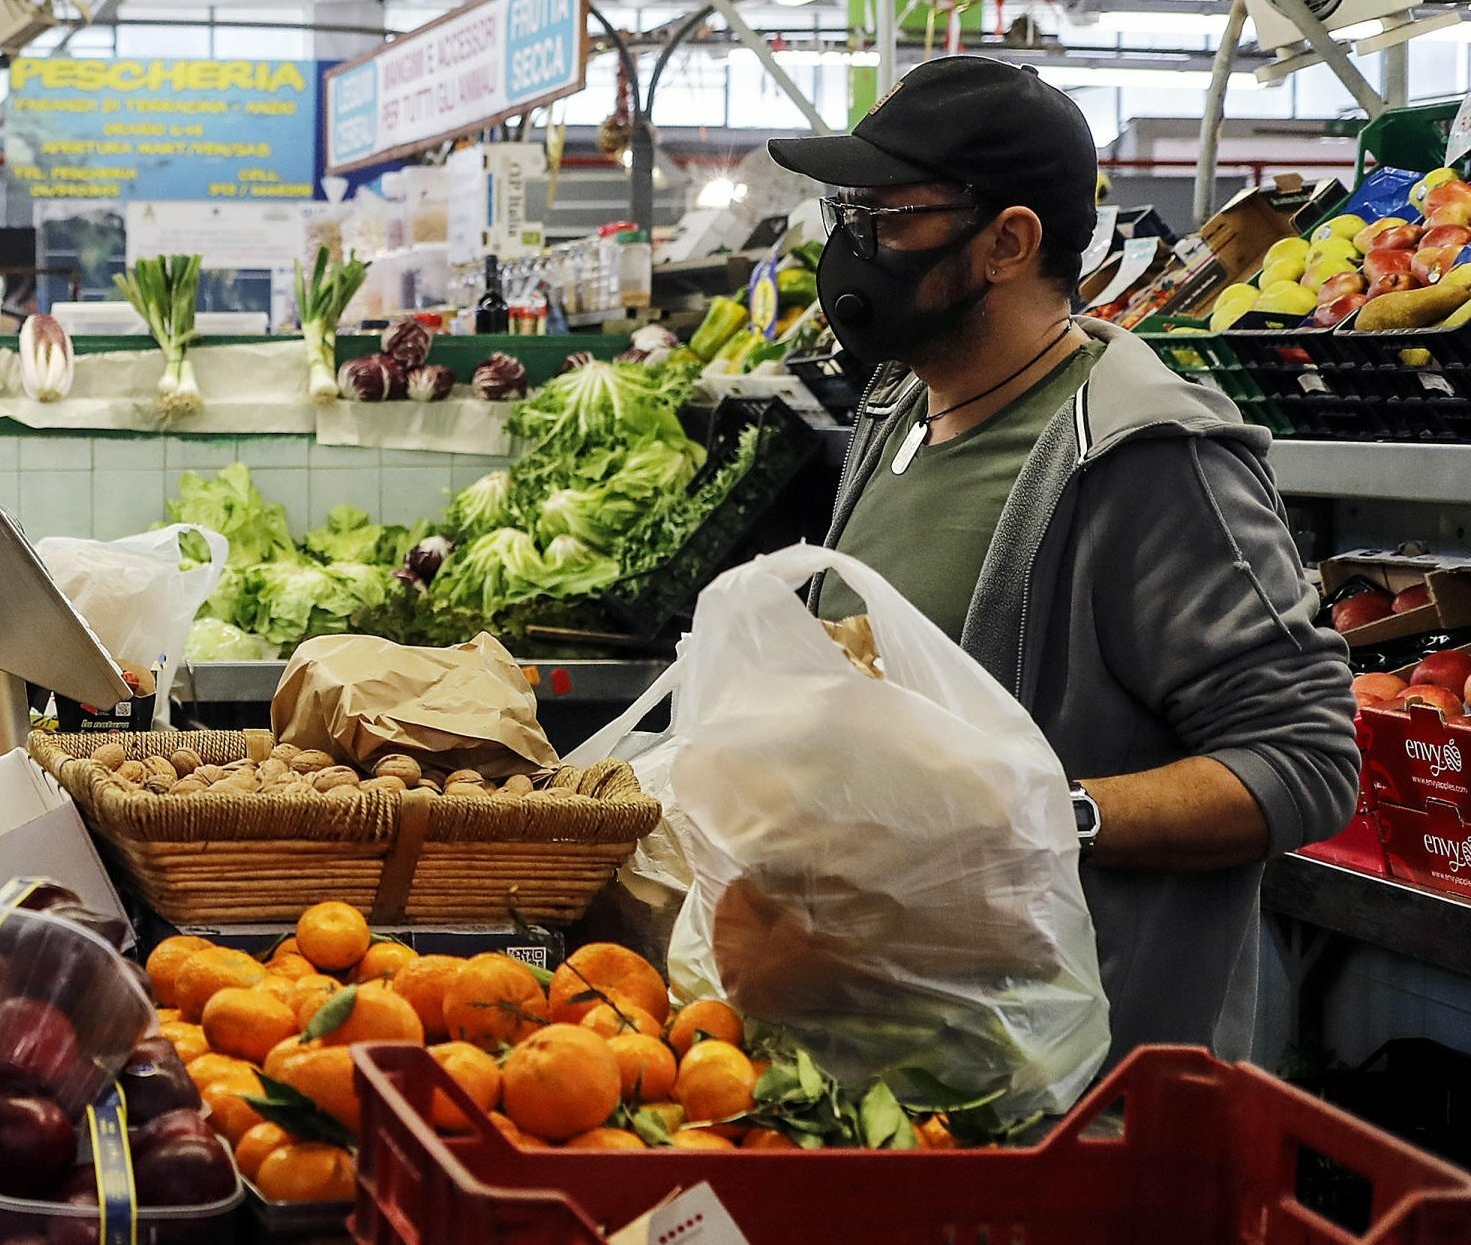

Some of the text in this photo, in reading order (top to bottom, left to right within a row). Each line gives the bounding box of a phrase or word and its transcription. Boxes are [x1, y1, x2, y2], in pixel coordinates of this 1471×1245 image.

[428, 44, 434, 75] E
[437, 14, 497, 68] ACCESSORI
[511, 34, 566, 92] SECCA
[10, 58, 306, 92] PESCHERIA
[383, 99, 399, 130] PER
[1405, 738, 1448, 777] envy
[1423, 833, 1466, 873] envy
